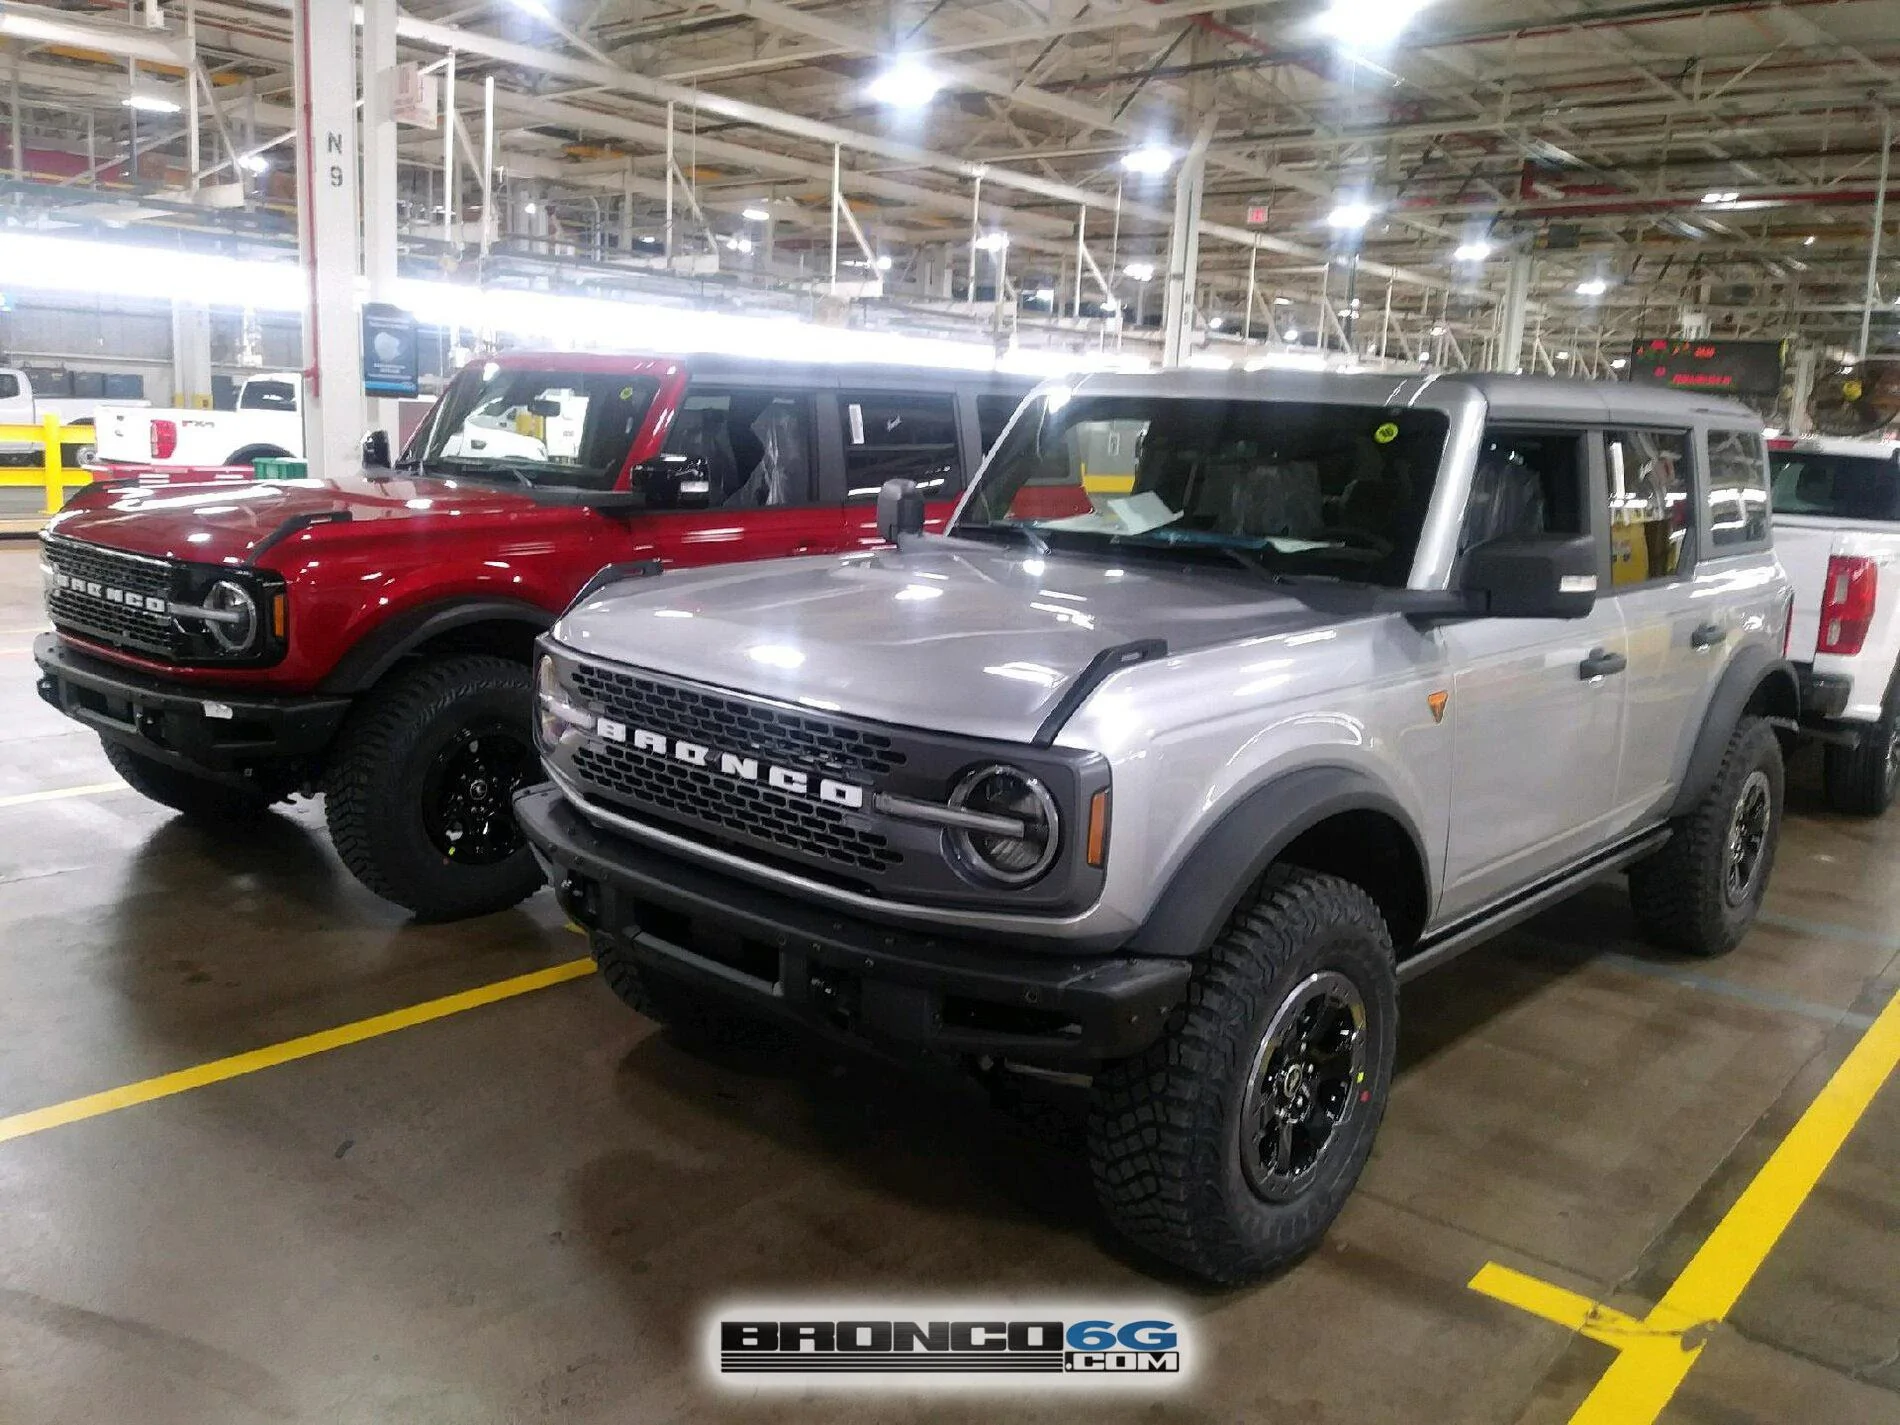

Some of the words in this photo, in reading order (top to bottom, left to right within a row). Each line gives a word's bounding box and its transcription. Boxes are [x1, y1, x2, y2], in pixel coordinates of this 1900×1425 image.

[328, 131, 342, 154] N
[330, 166, 343, 187] 9
[597, 717, 863, 808] BRONCO
